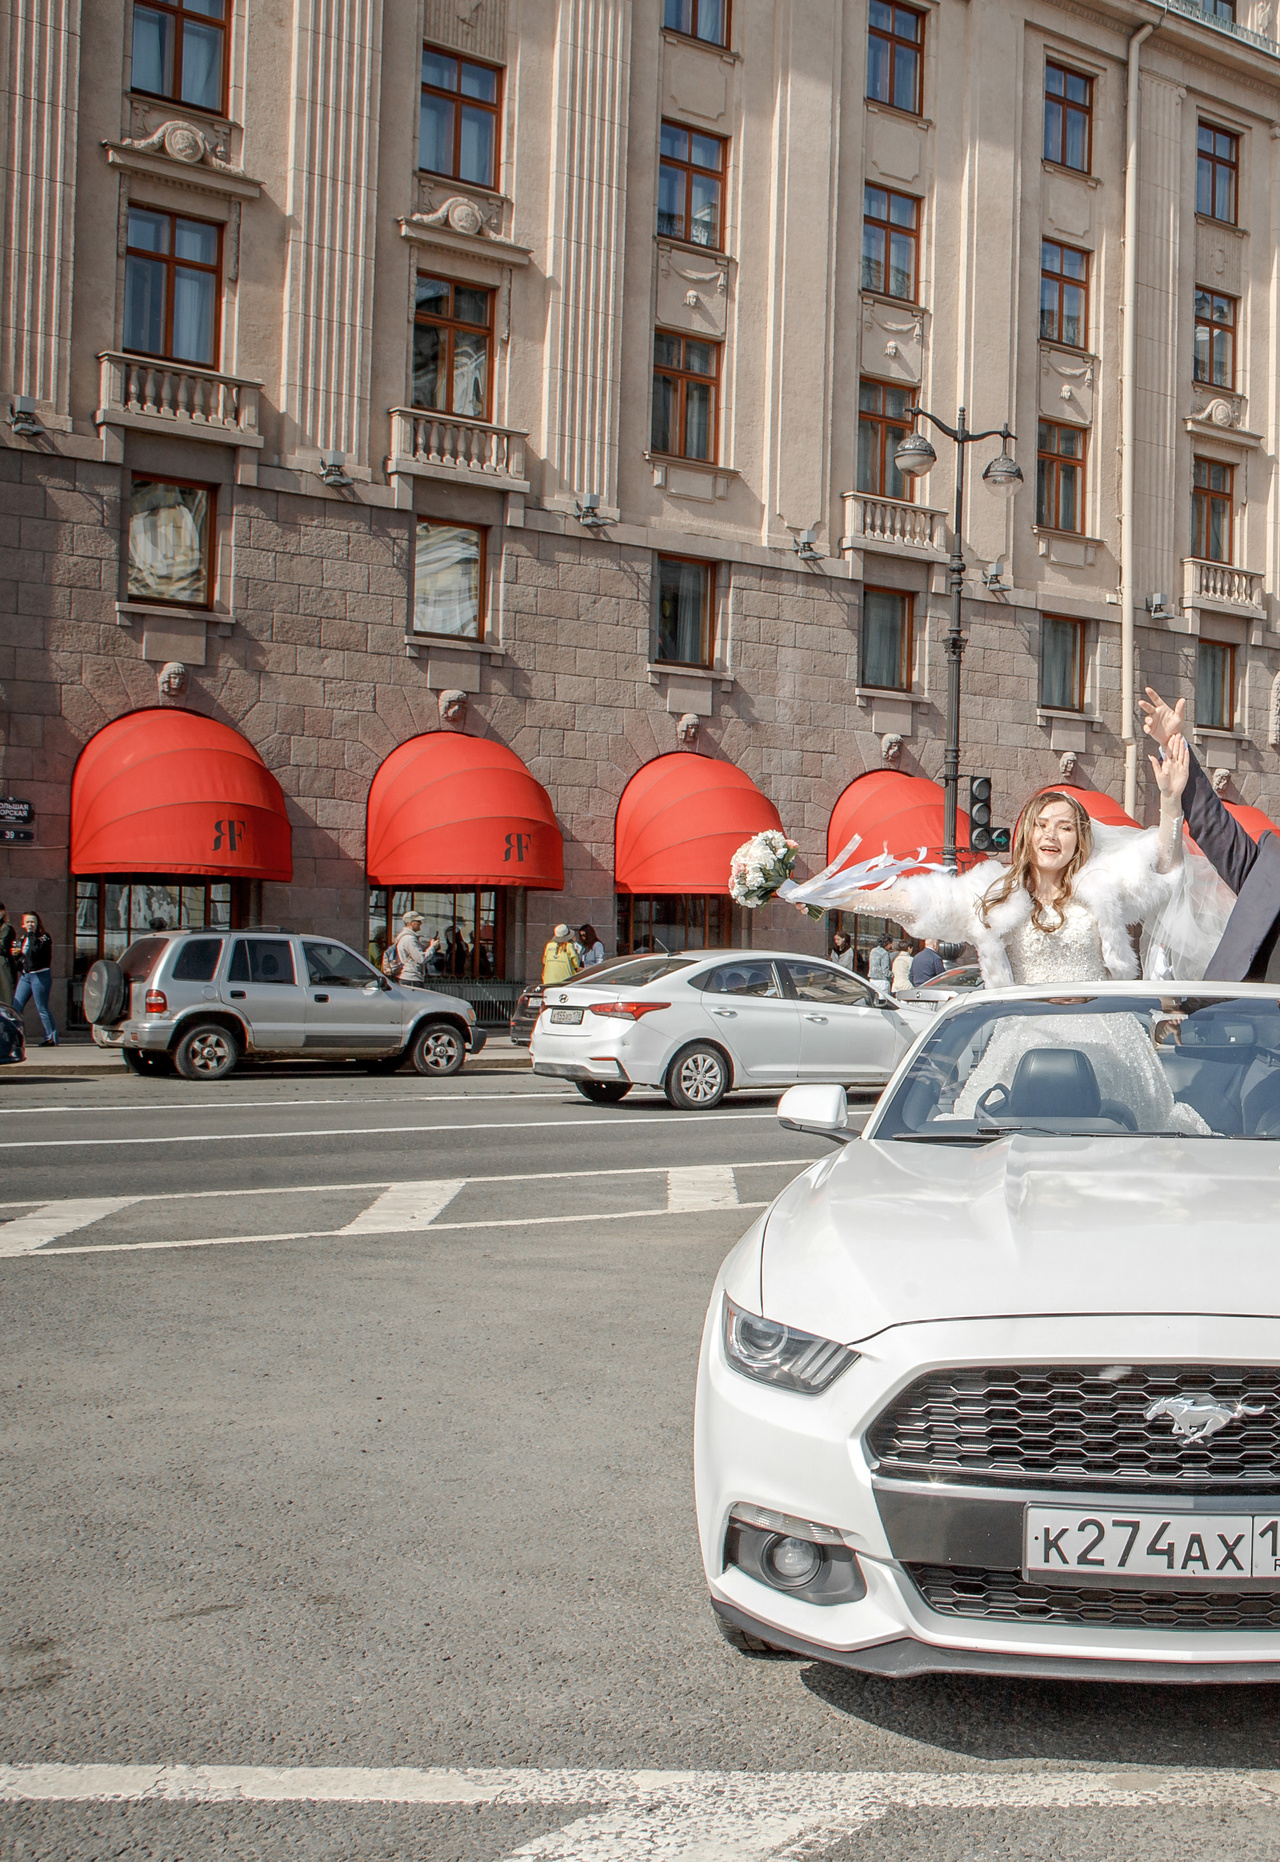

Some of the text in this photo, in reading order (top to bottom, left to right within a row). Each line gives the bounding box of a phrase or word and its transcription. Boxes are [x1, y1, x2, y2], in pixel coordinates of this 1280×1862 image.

[0, 809, 28, 817] ОРСКАЯ
[5, 830, 15, 839] 39
[1043, 1518, 1245, 1571] К274АХ
